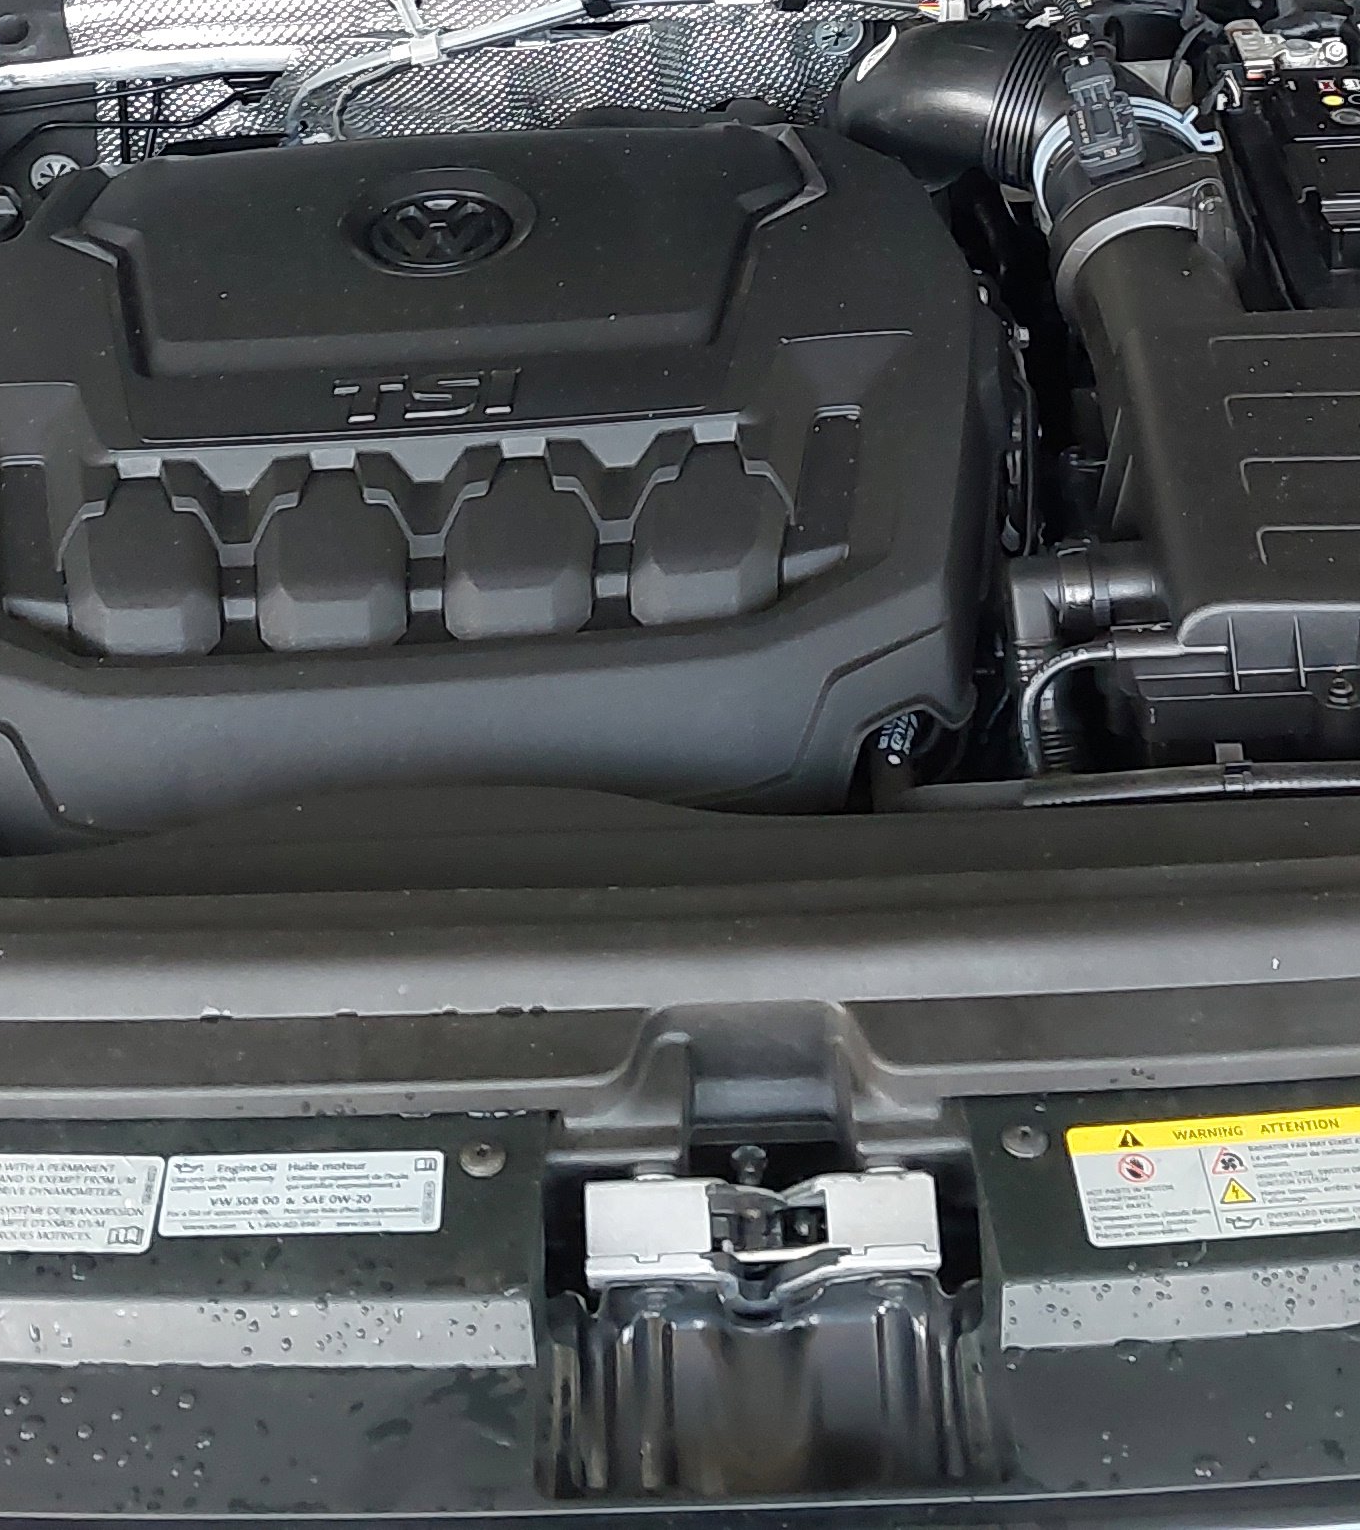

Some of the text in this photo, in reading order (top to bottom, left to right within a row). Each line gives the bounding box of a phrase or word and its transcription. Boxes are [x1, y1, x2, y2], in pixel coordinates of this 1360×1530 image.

[333, 368, 522, 423] TSI
[1172, 1118, 1340, 1141] WARNING ATTENTION
[217, 1162, 277, 1175] Engine Oil
[288, 1161, 366, 1171] Huile moteur
[210, 1194, 372, 1206] VW 508 00 & SAE 0W-20
